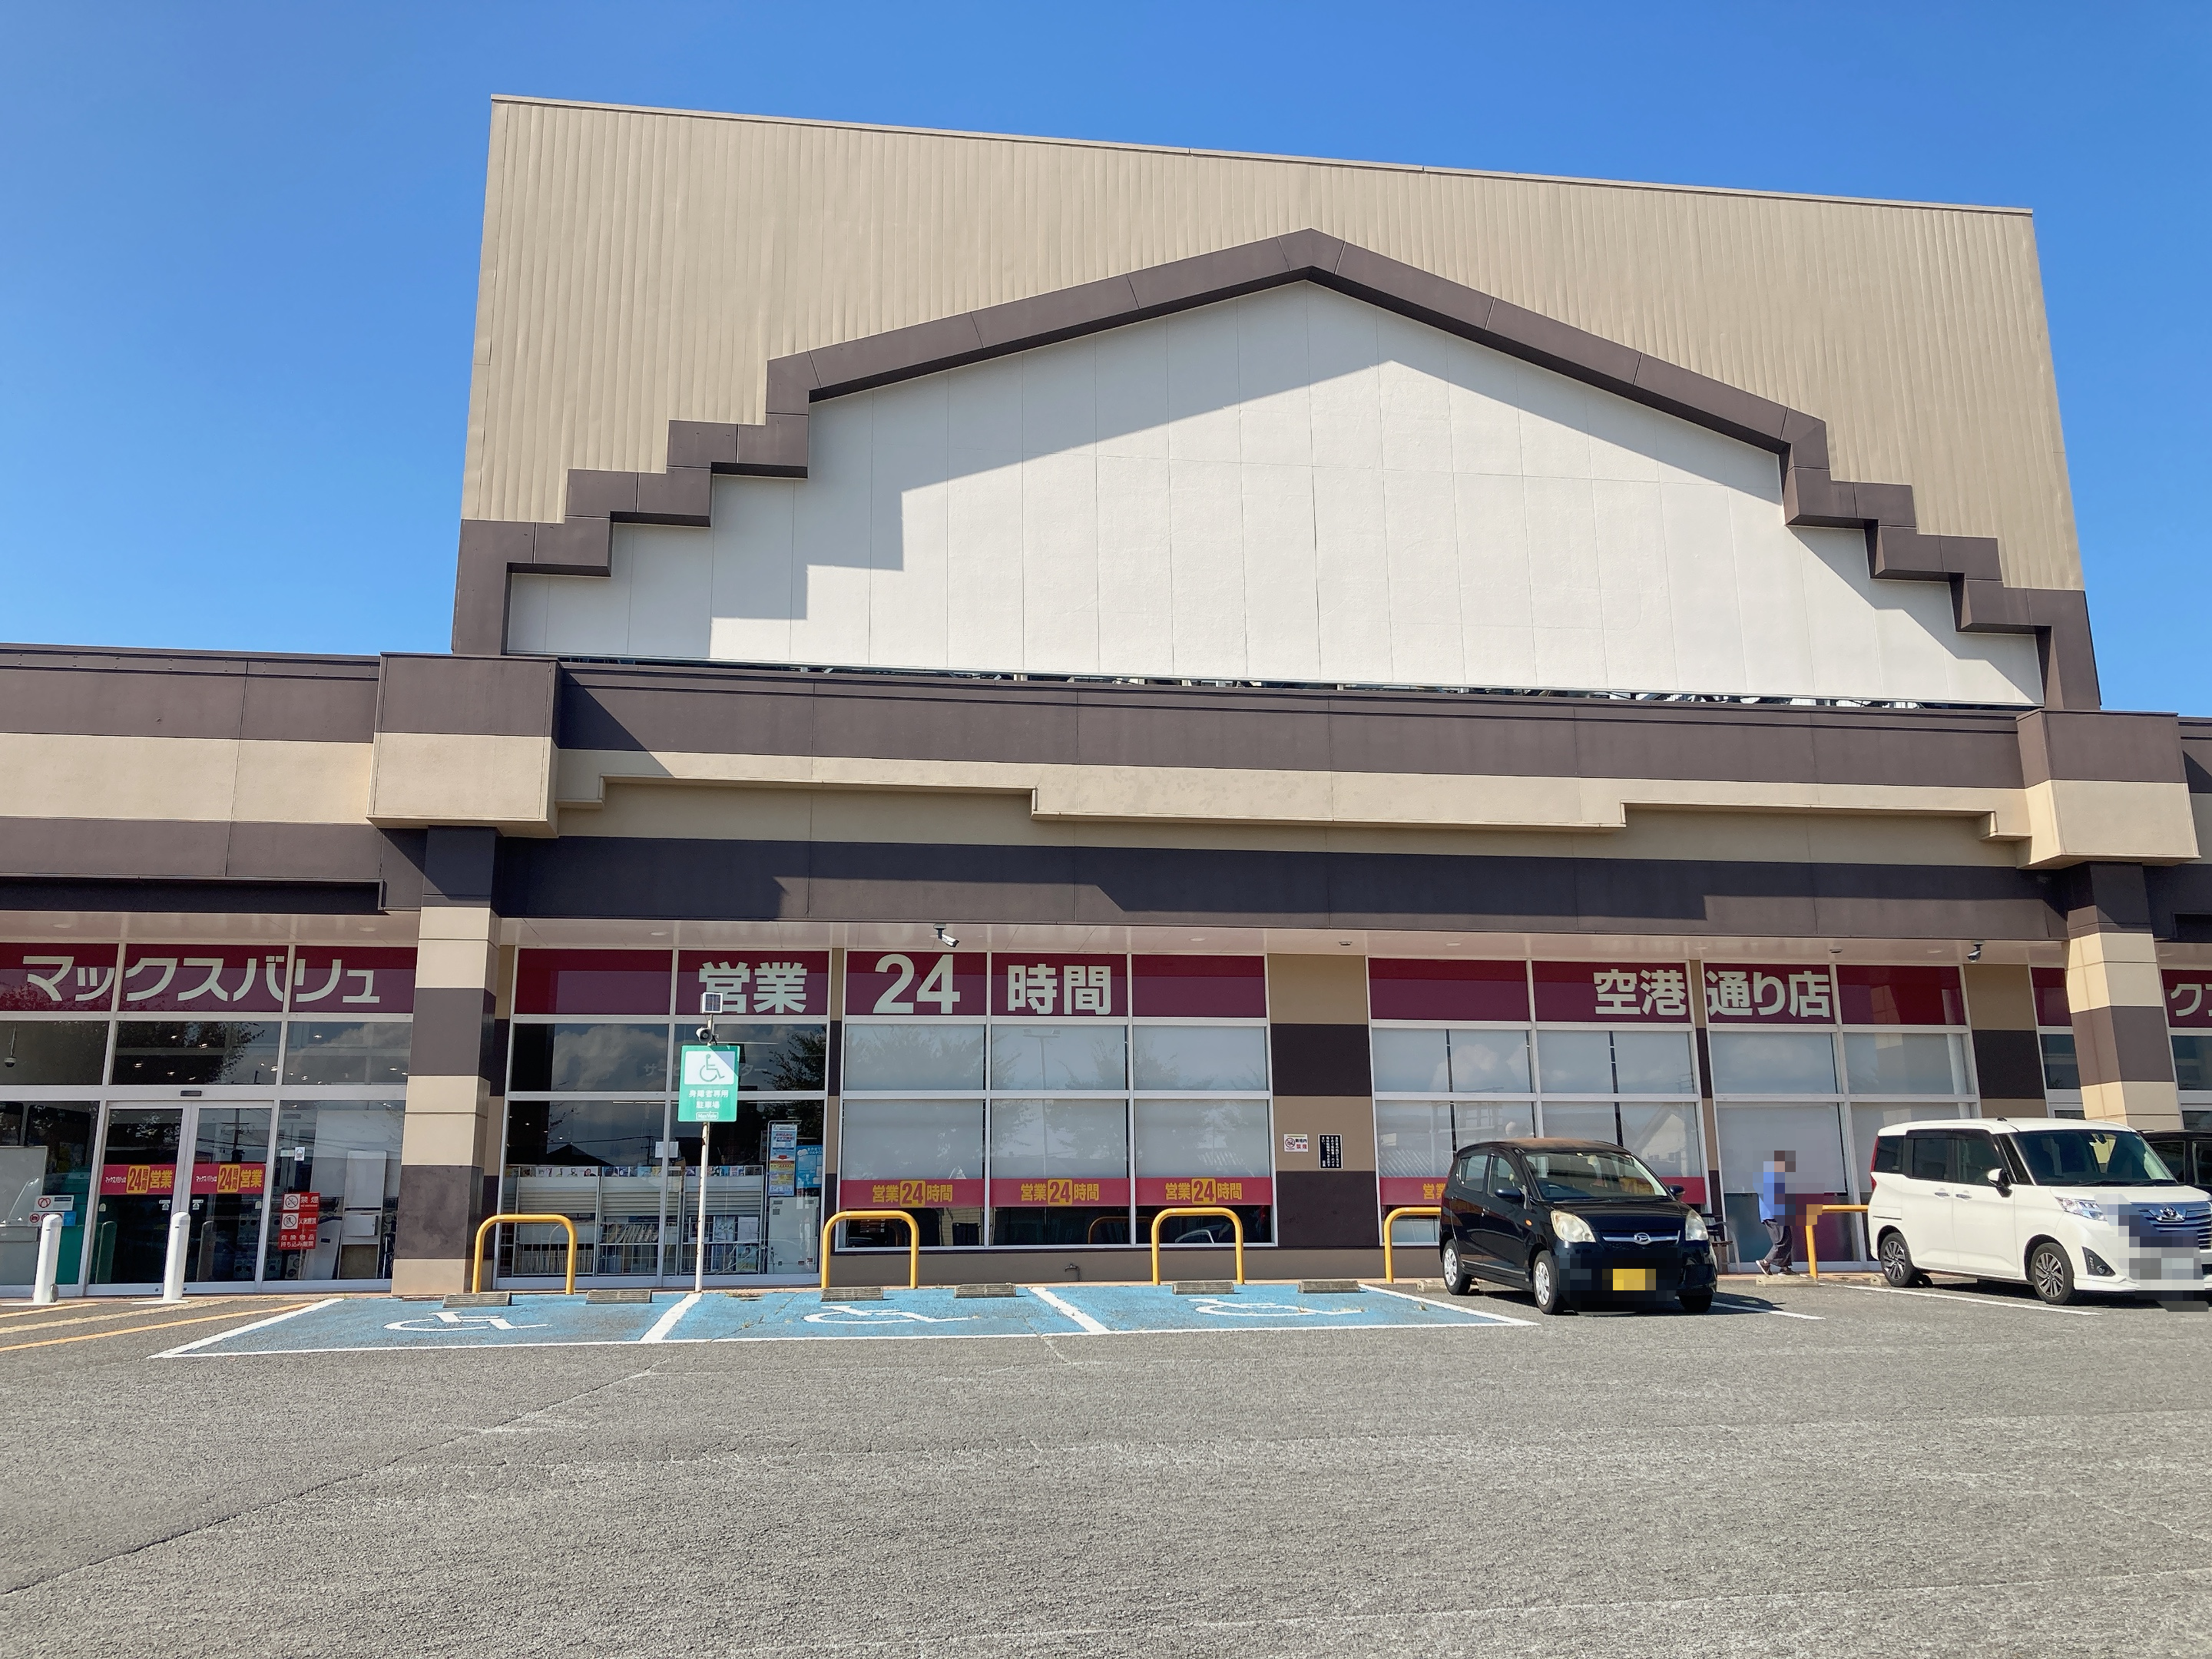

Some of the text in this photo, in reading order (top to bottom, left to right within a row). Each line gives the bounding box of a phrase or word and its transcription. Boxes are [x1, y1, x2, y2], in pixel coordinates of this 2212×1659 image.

[22, 955, 380, 1004] マックスバリュ
[698, 954, 1111, 1015] 営業 24 時間
[1593, 969, 1831, 1018] 空港通り店
[2170, 983, 2212, 1017] ク
